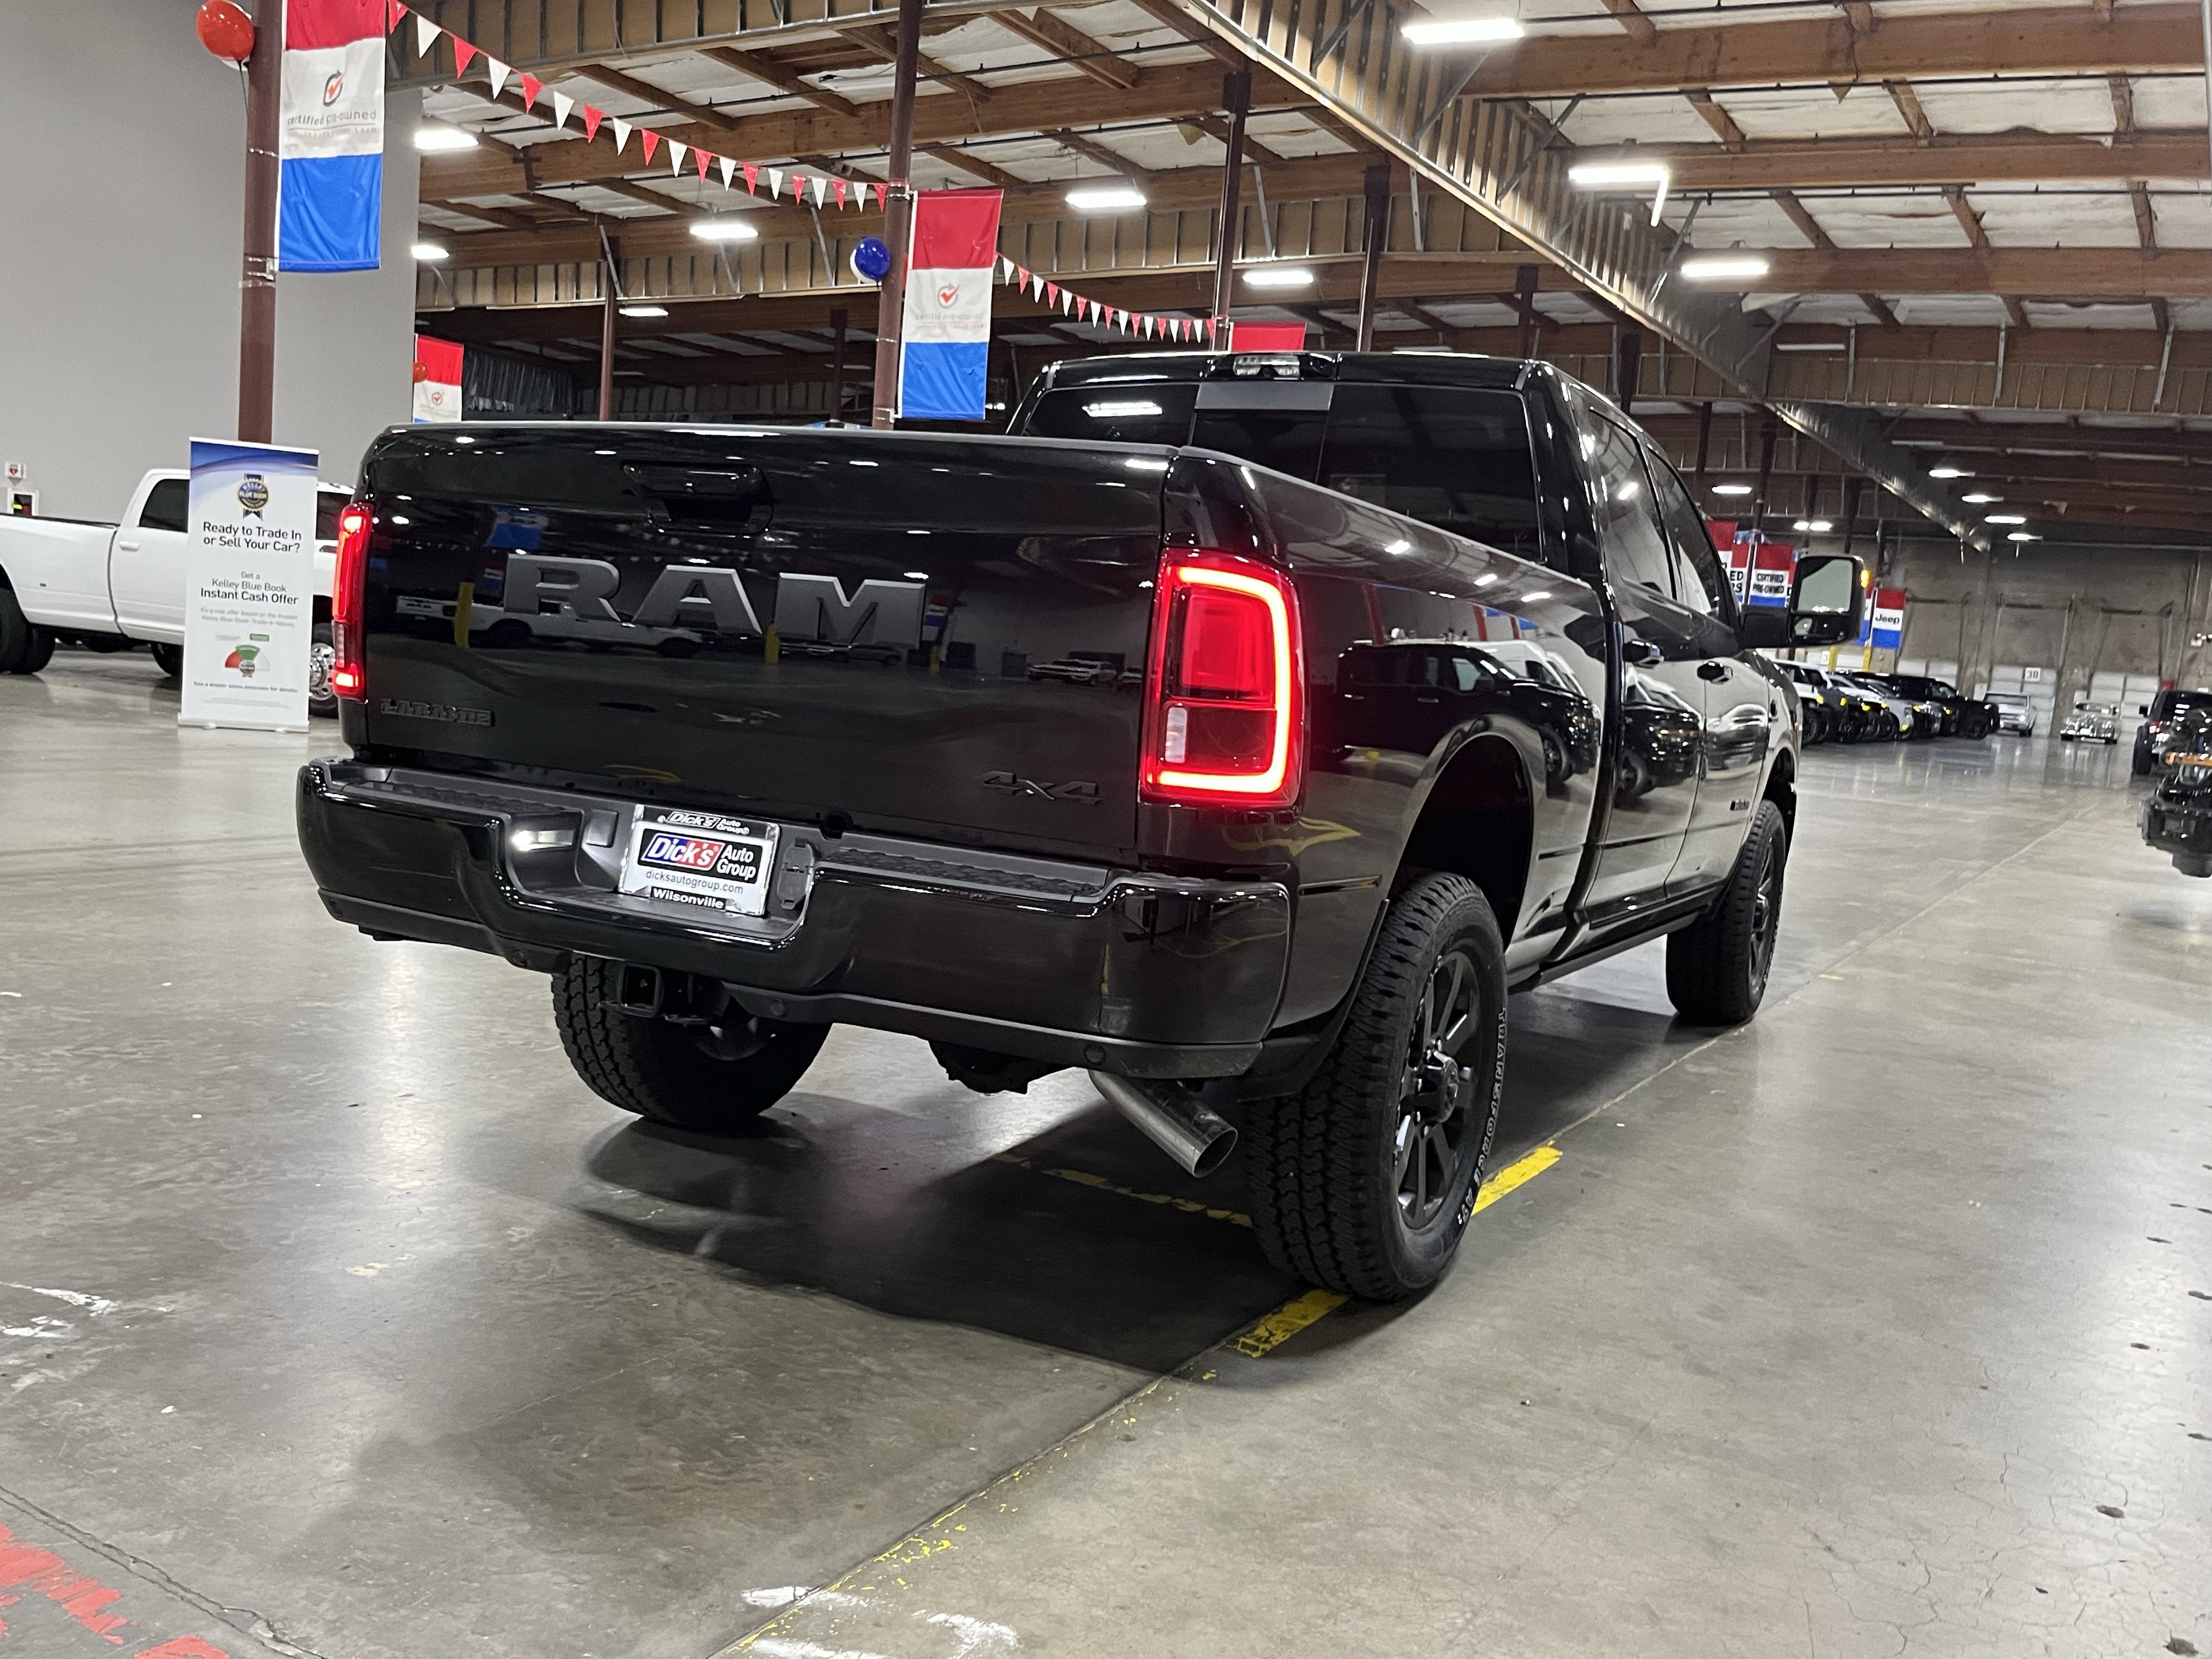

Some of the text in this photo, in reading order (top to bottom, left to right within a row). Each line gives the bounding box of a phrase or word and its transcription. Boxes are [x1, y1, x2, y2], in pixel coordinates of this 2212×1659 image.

[287, 114, 324, 126] certified
[204, 522, 301, 540] Ready to Trade In
[219, 536, 241, 548] Sell
[245, 538, 270, 550] Your
[274, 541, 301, 553] Car?
[241, 571, 254, 579] Get
[212, 578, 286, 592] Kelley Blue Book
[201, 588, 299, 605] Instant Cash Offer
[503, 552, 926, 650] RAM
[1875, 614, 1900, 625] Jeep
[720, 819, 741, 827] Auto
[721, 844, 754, 863] Auto
[716, 859, 756, 881] Group
[646, 870, 743, 894] dicksautogroup.com
[653, 888, 724, 909] Wilsonville
